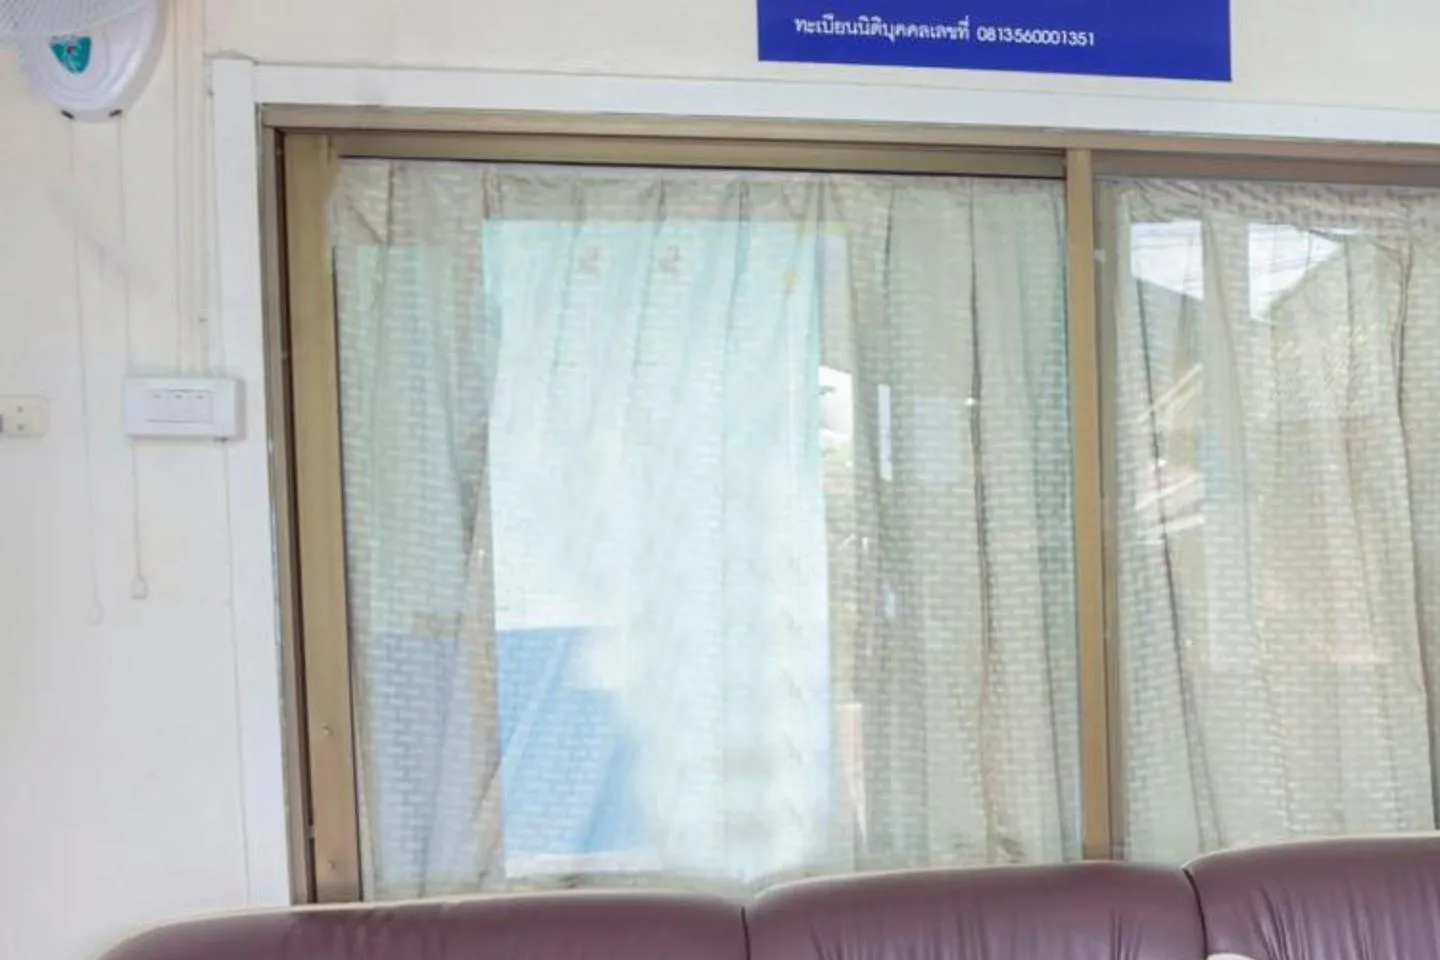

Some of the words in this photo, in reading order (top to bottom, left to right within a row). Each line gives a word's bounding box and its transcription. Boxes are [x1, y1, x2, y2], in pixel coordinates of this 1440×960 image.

[794, 13, 970, 43] ทะเบียนนิติบุคคลเลขที่
[976, 26, 1095, 46] 0813560001351
